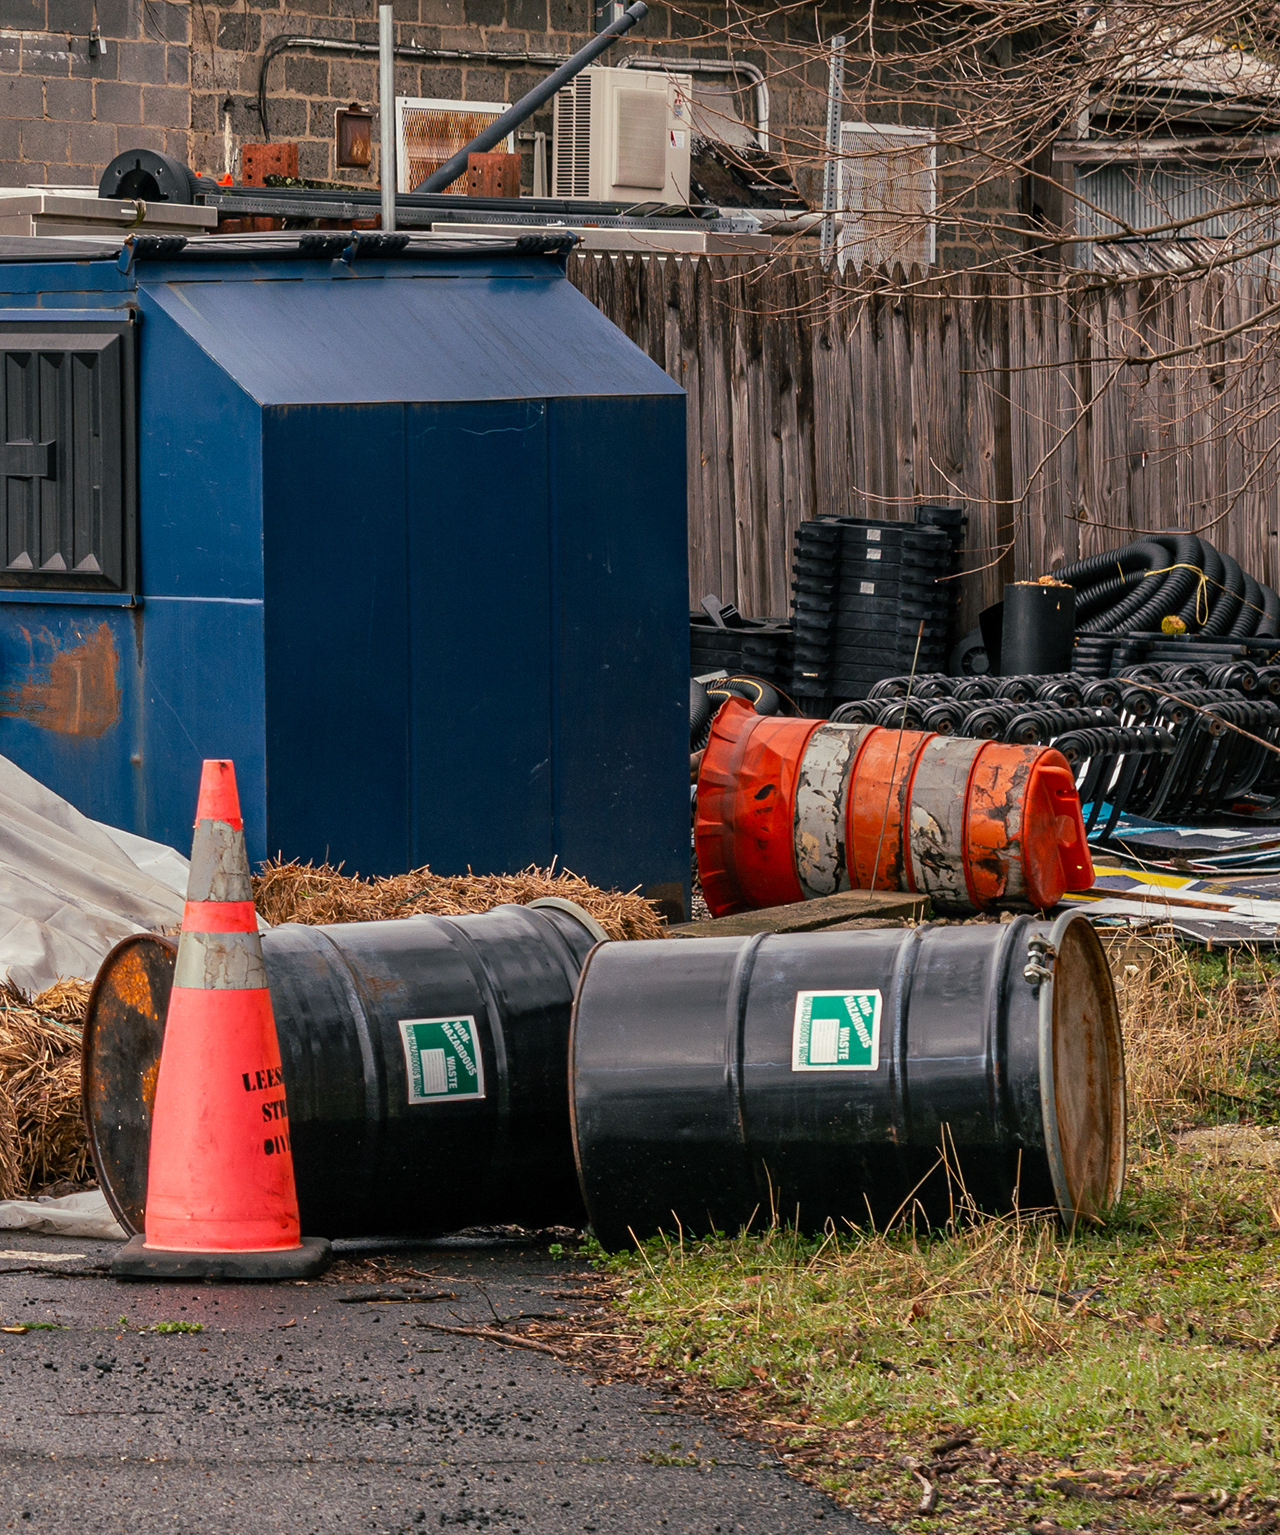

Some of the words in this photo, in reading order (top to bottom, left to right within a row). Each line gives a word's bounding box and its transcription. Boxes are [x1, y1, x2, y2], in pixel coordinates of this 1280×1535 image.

[843, 995, 873, 1049] HAZARDOUS
[857, 995, 873, 1017] NON-
[440, 1021, 477, 1077] HAZARDOUS
[453, 1021, 471, 1044] NON-
[838, 1026, 850, 1060] WASTE
[446, 1055, 458, 1090] WASTE
